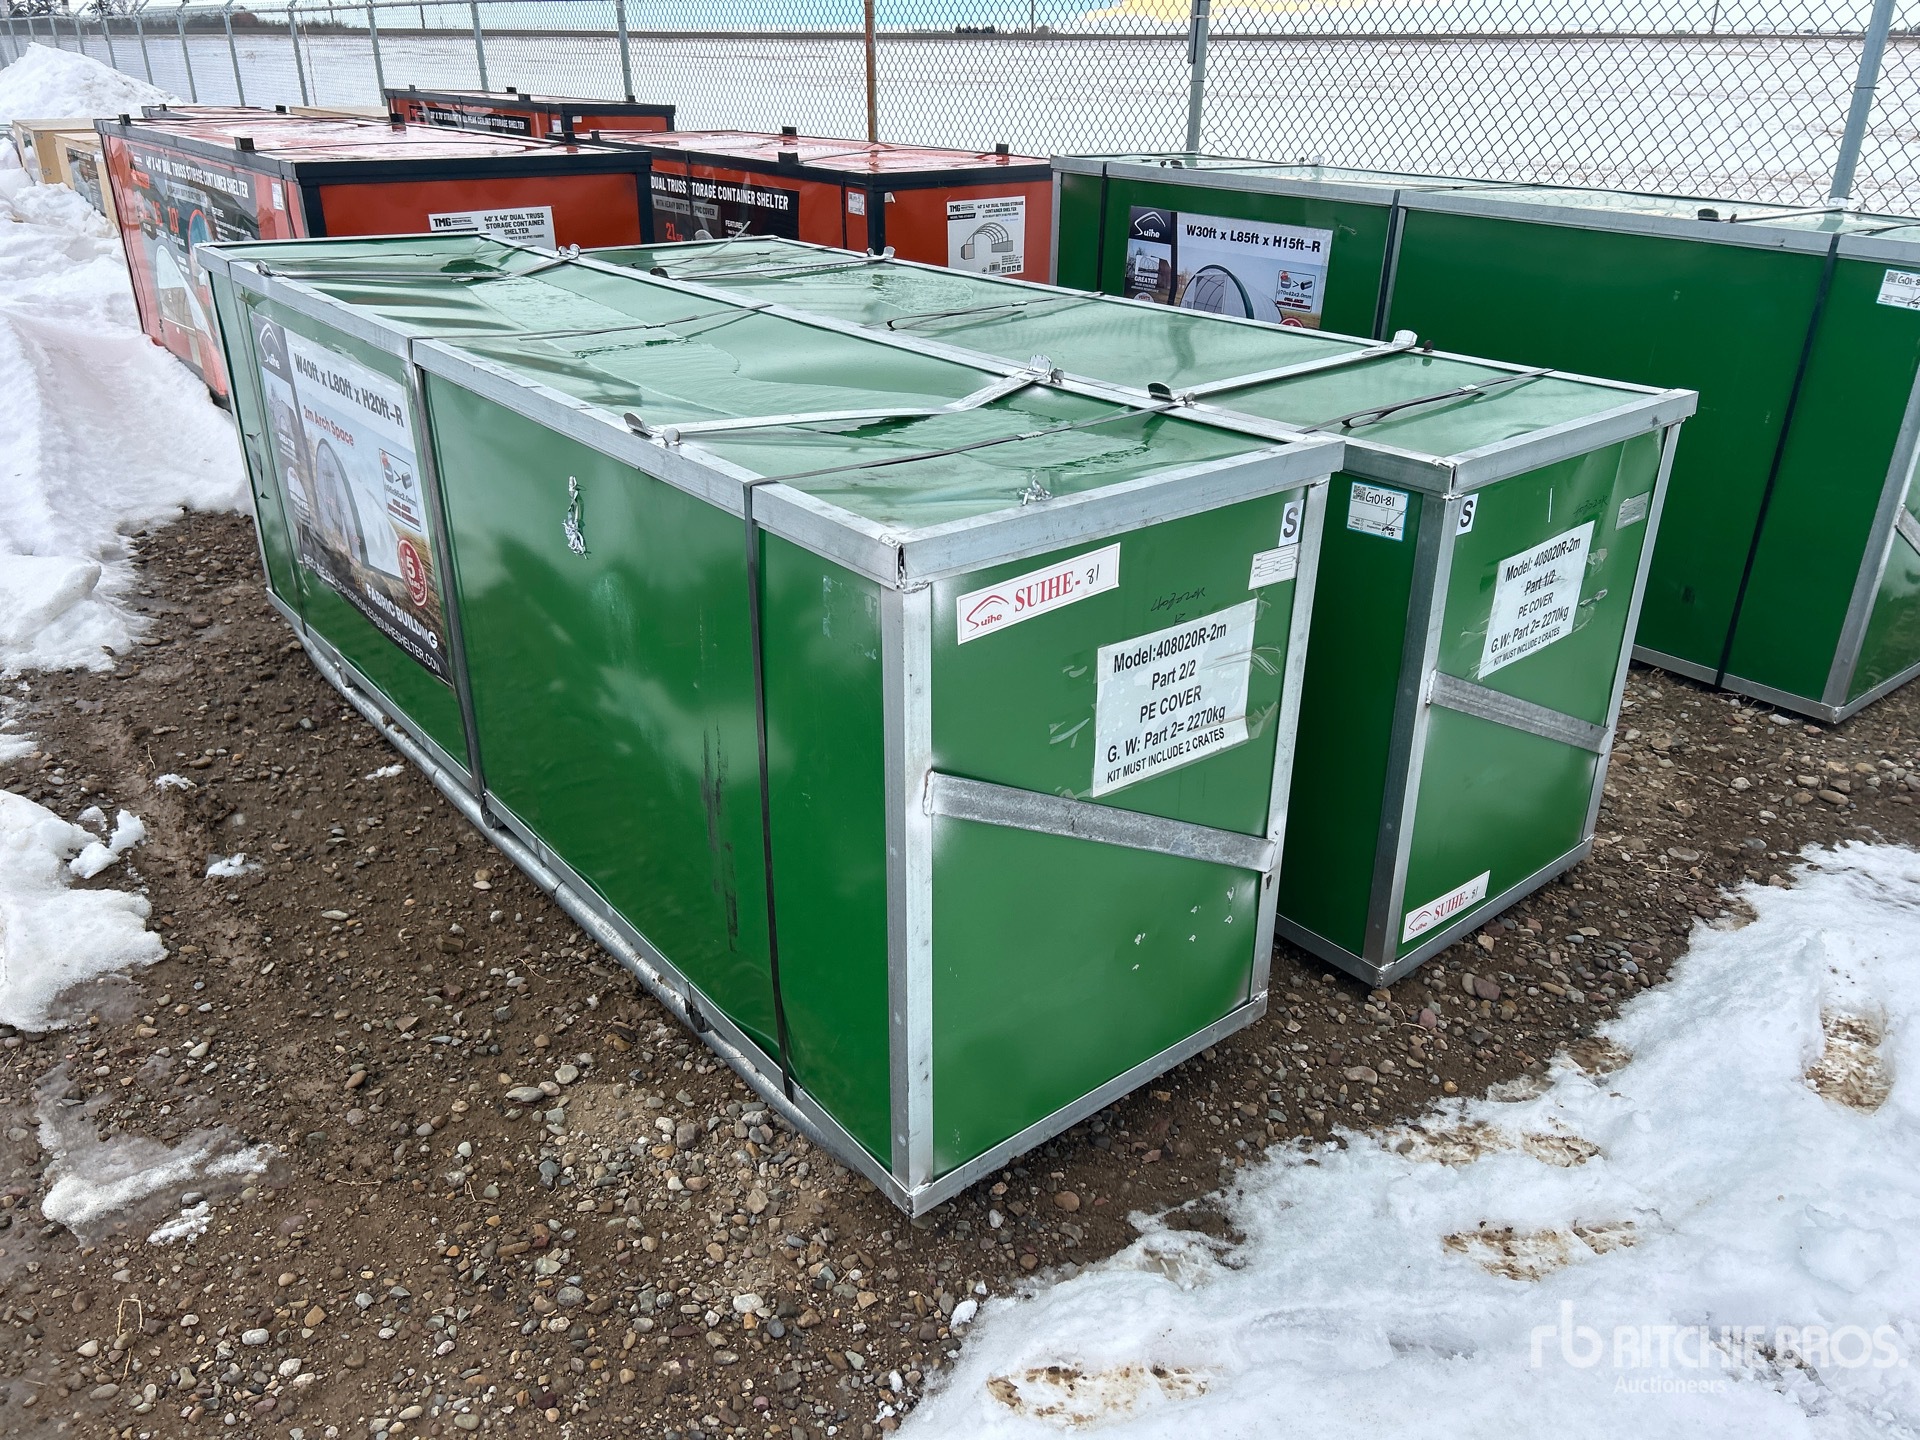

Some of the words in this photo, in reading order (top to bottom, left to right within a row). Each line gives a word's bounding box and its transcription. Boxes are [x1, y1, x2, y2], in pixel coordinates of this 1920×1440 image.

[650, 175, 667, 190] DUAL
[667, 178, 687, 194] TRUSS
[687, 181, 717, 199] TORAGE
[717, 186, 756, 205] CONTAINER
[756, 191, 789, 211] SHELTER
[433, 217, 452, 228] TMG
[485, 221, 512, 230] STORAGE
[512, 219, 545, 228] CONTAINER
[503, 227, 530, 236] SHELTER
[509, 213, 525, 221] DUAL
[525, 212, 545, 220] TRUSS
[1186, 224, 1217, 240] W30ft
[1220, 232, 1226, 241] x
[1229, 230, 1260, 245] L85ft
[1263, 238, 1270, 246] x
[1134, 275, 1158, 285] GREATER
[294, 352, 319, 383] W40ft
[320, 371, 328, 387] x
[327, 370, 353, 400] L80ft
[353, 388, 361, 405] x
[314, 411, 330, 435] Arch
[330, 420, 354, 447] Space
[1283, 507, 1299, 538] S
[1460, 500, 1474, 528] S
[406, 555, 416, 579] 5
[1505, 559, 1533, 583] Model:
[1533, 537, 1581, 568] 408020R-2m
[1524, 576, 1544, 597] Part
[1544, 569, 1556, 589] 1/2
[365, 582, 396, 617] FABRIC
[395, 605, 438, 649] BUILDING
[1517, 604, 1529, 620] PE
[1528, 591, 1554, 614] COVER
[1512, 625, 1530, 644] Part
[1540, 605, 1570, 631] 2270kg
[1113, 623, 1227, 674] Model:408020R-2m
[1493, 653, 1502, 667] KIT
[1502, 647, 1517, 662] MUST
[1517, 638, 1538, 656] INCLUDE
[1541, 626, 1561, 644] CRATES
[1151, 667, 1176, 691] Part
[1178, 659, 1196, 682] 2/2
[1139, 701, 1156, 724] PE
[1159, 685, 1202, 716] COVER
[1107, 744, 1120, 763] G.
[1125, 737, 1141, 757] W:
[1144, 727, 1168, 750] Part
[1169, 720, 1185, 740] 2=
[1186, 705, 1226, 733] 2270kg
[1107, 767, 1121, 784] KIT
[1122, 758, 1147, 778] MUST
[1148, 745, 1184, 768] INCLUDE
[1185, 740, 1191, 753] 2
[1191, 727, 1225, 750] CRATES
